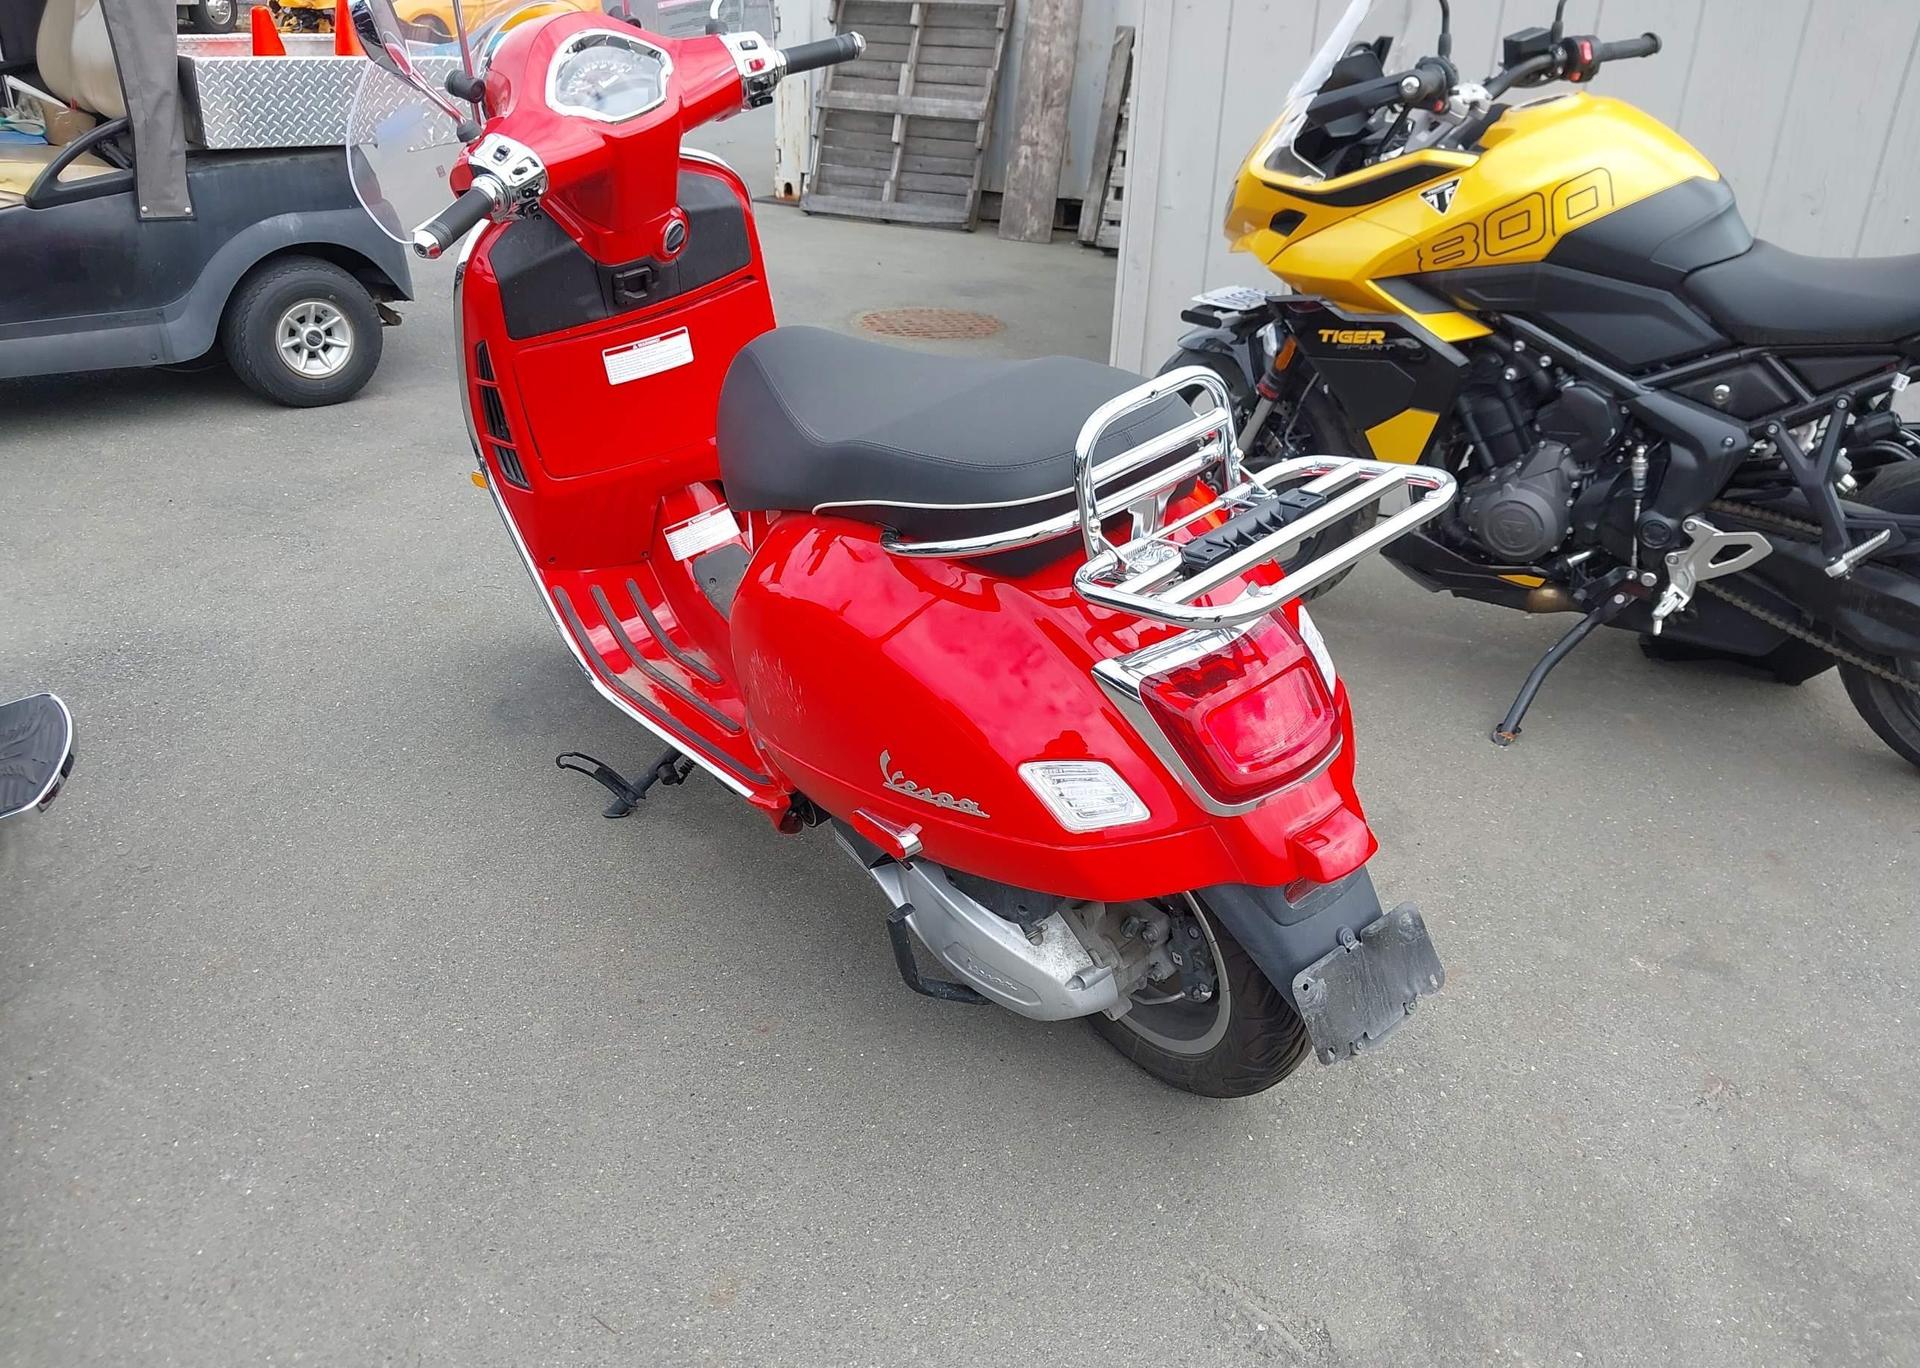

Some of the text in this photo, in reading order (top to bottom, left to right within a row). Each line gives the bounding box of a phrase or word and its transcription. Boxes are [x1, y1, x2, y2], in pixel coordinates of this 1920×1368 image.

[1417, 167, 1615, 272] 800
[1318, 329, 1386, 344] TIGER
[880, 749, 990, 818] Vespa
